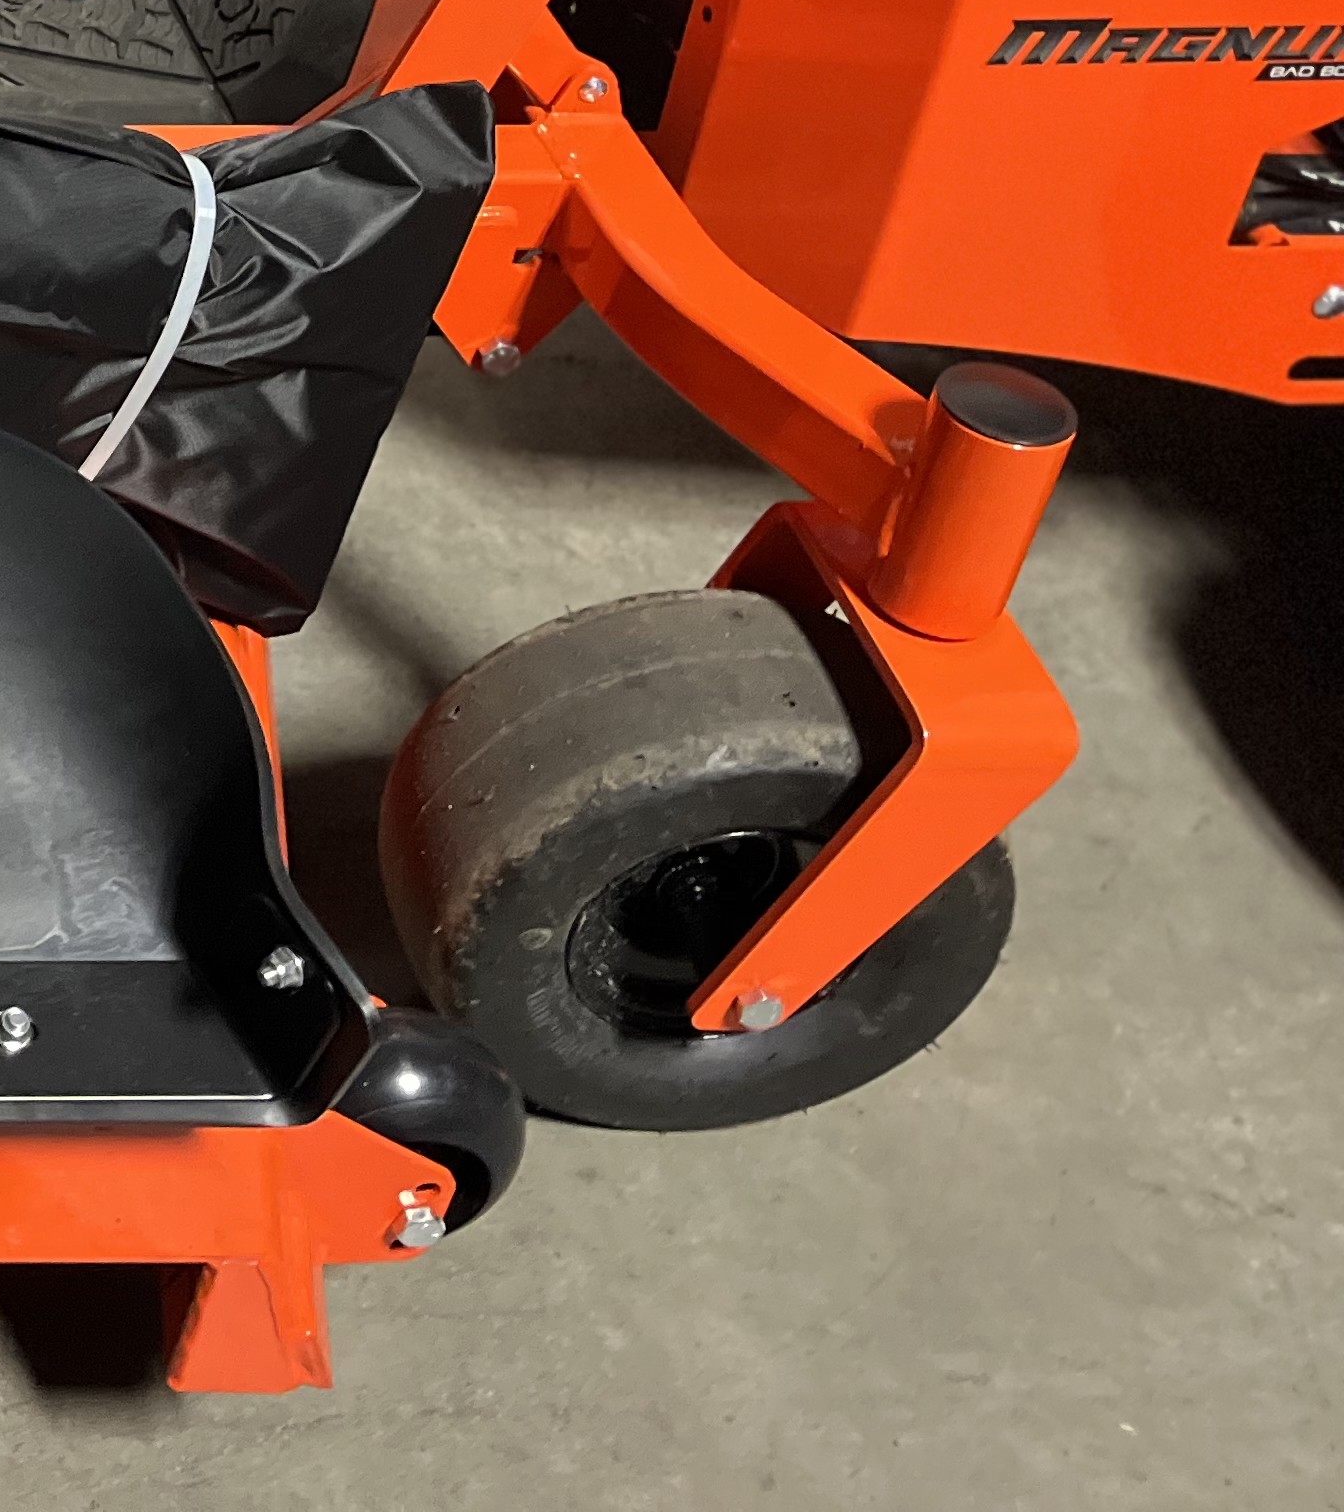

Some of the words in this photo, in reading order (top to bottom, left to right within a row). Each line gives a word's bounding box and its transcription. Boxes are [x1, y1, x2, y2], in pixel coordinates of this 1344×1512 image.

[987, 18, 1343, 66] MAGNU
[1269, 64, 1315, 79] BAD
[1319, 64, 1343, 78] BO
